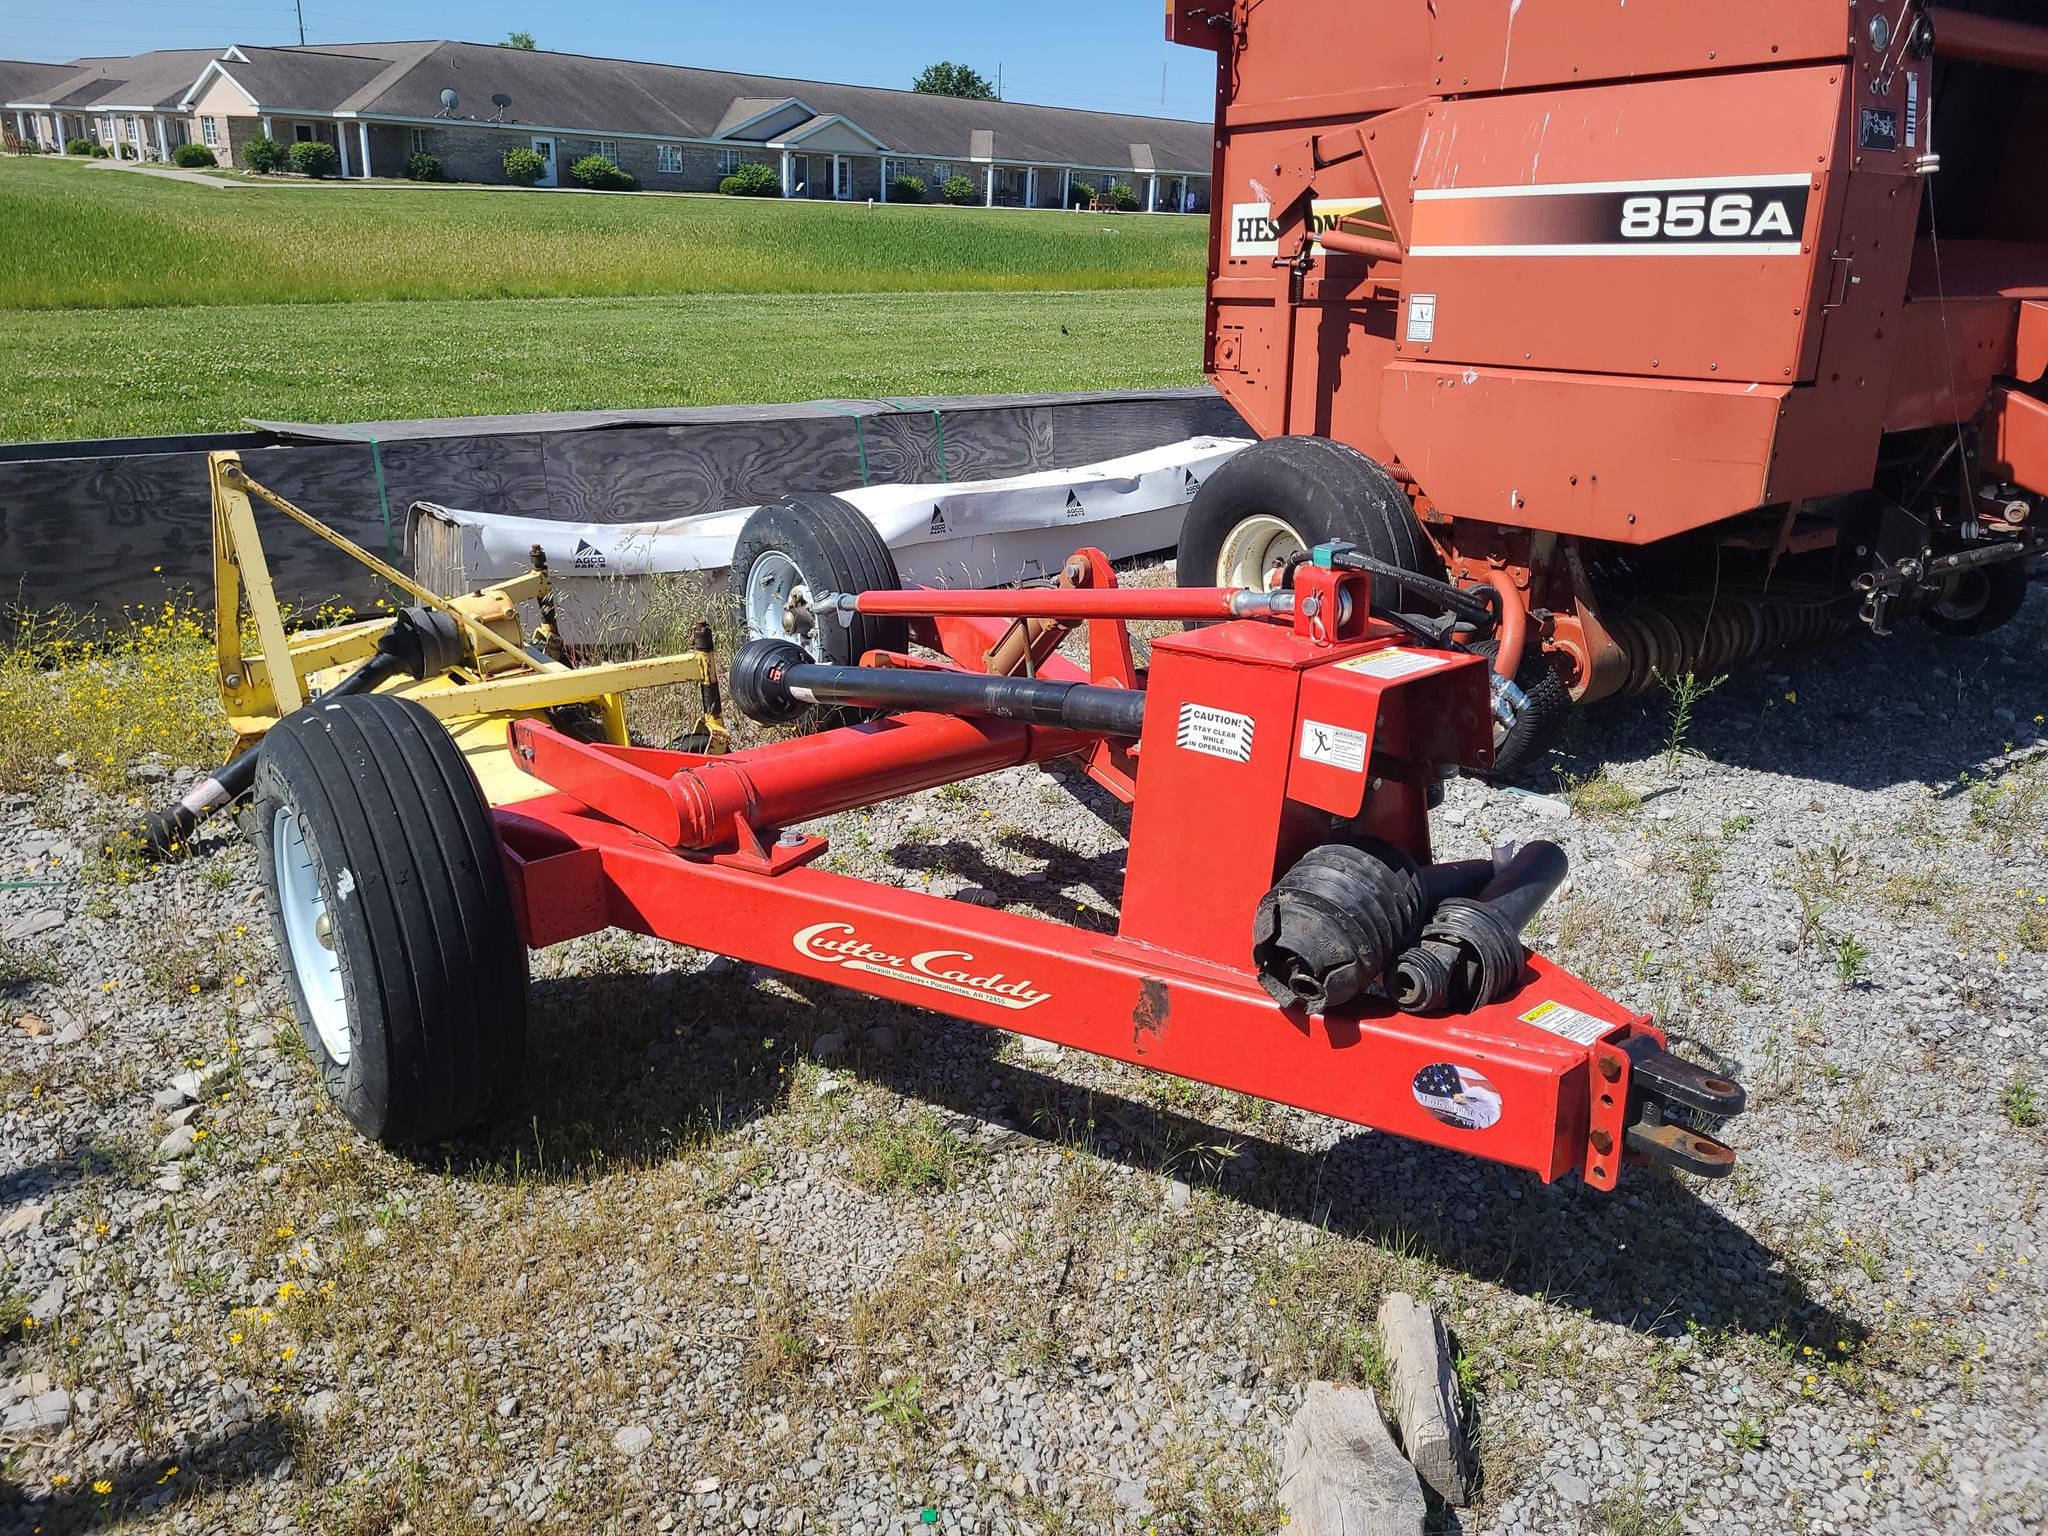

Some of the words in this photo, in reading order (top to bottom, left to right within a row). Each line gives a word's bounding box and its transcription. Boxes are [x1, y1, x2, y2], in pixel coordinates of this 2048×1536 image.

[1620, 194, 1794, 238] 856A
[931, 523, 946, 531] AGCO
[1193, 710, 1242, 728] CAUTION!
[1193, 724, 1212, 734] STAY
[1213, 728, 1237, 740] CLEAR
[1202, 734, 1225, 745] WHILE
[1198, 742, 1238, 757] OPERATION
[792, 922, 905, 967] Cutter
[910, 950, 1053, 1006] Caddy
[892, 971, 925, 984] Industries
[929, 980, 972, 996] Pocahontas,
[973, 991, 984, 999] AR
[1419, 1093, 1446, 1108] Made
[1469, 1108, 1492, 1123] USA
